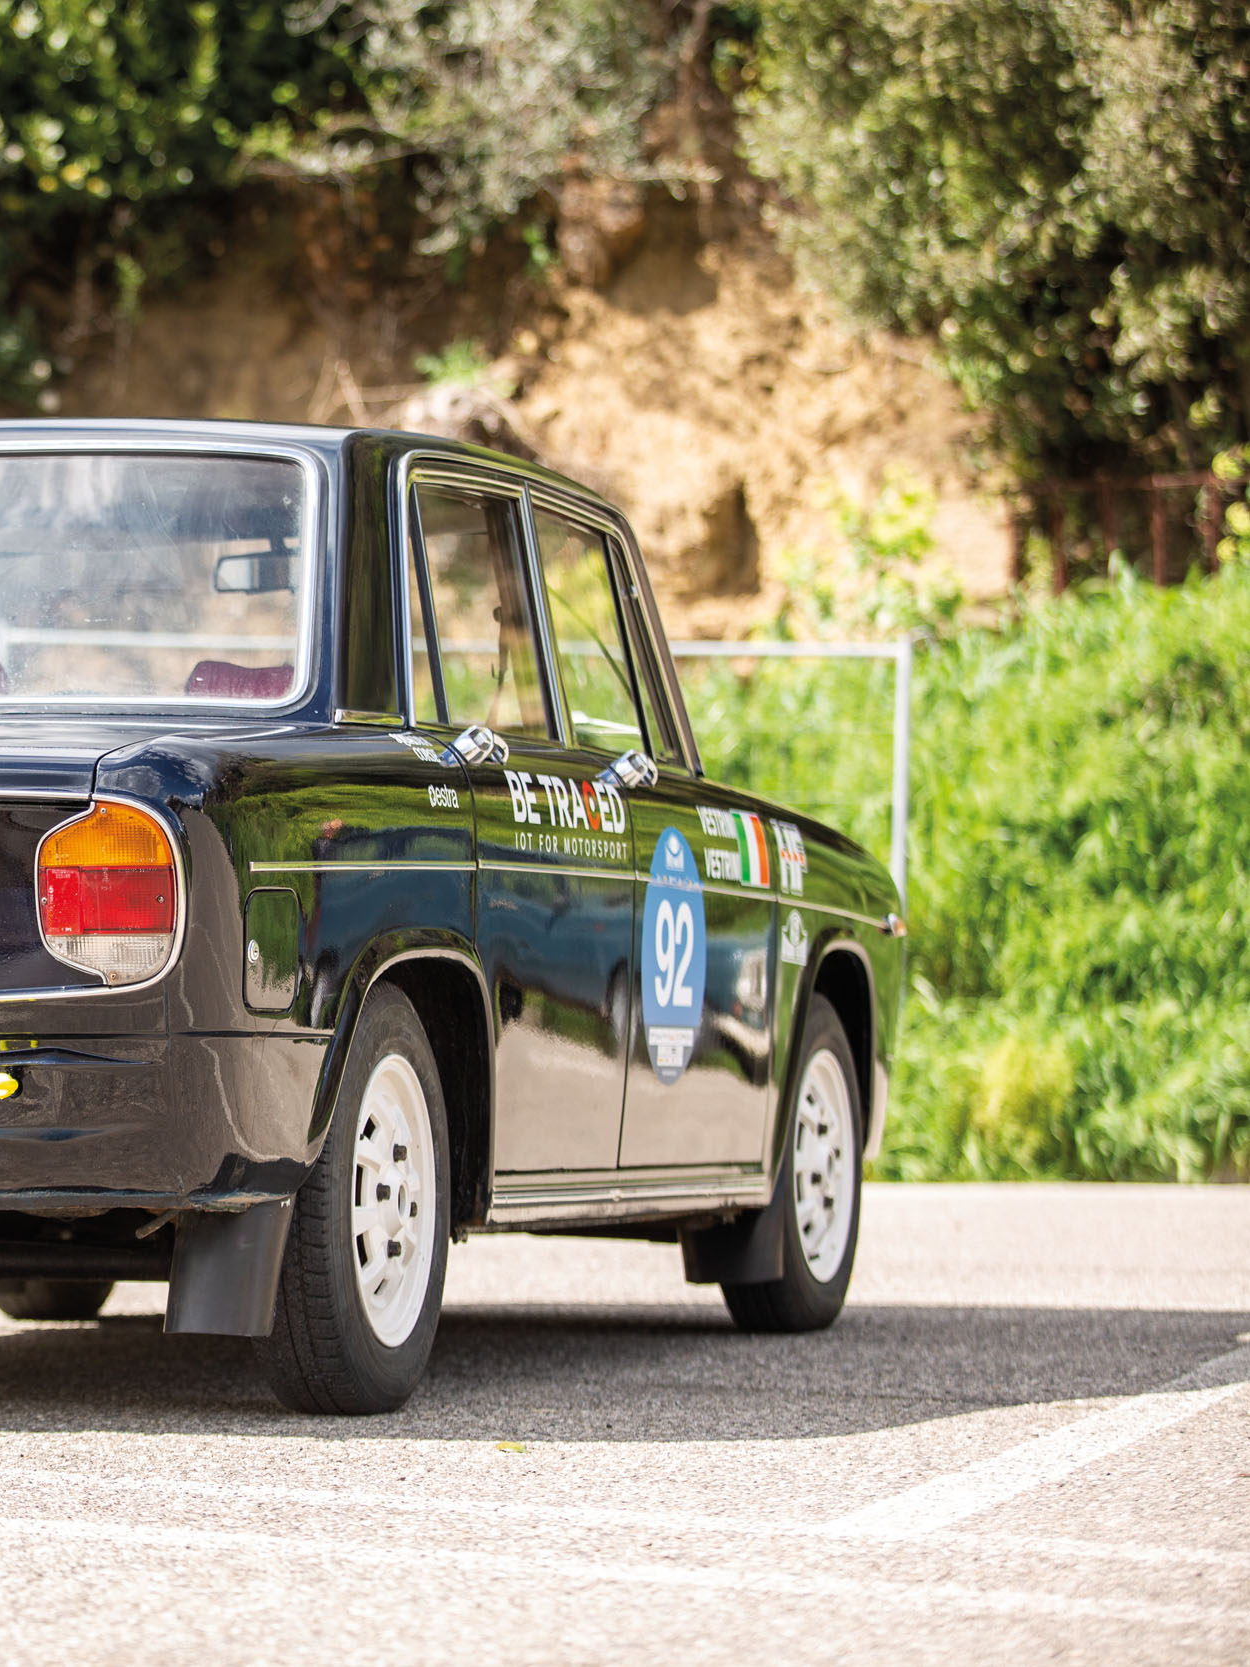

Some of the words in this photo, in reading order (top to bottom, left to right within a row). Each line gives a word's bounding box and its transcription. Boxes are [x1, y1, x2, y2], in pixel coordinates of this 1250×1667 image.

[503, 769, 541, 825] BE
[536, 773, 626, 834] TRACED
[515, 831, 533, 851] IOT
[538, 833, 558, 854] FOR
[563, 837, 628, 861] MOTORSPORT
[654, 899, 695, 1008] 92
